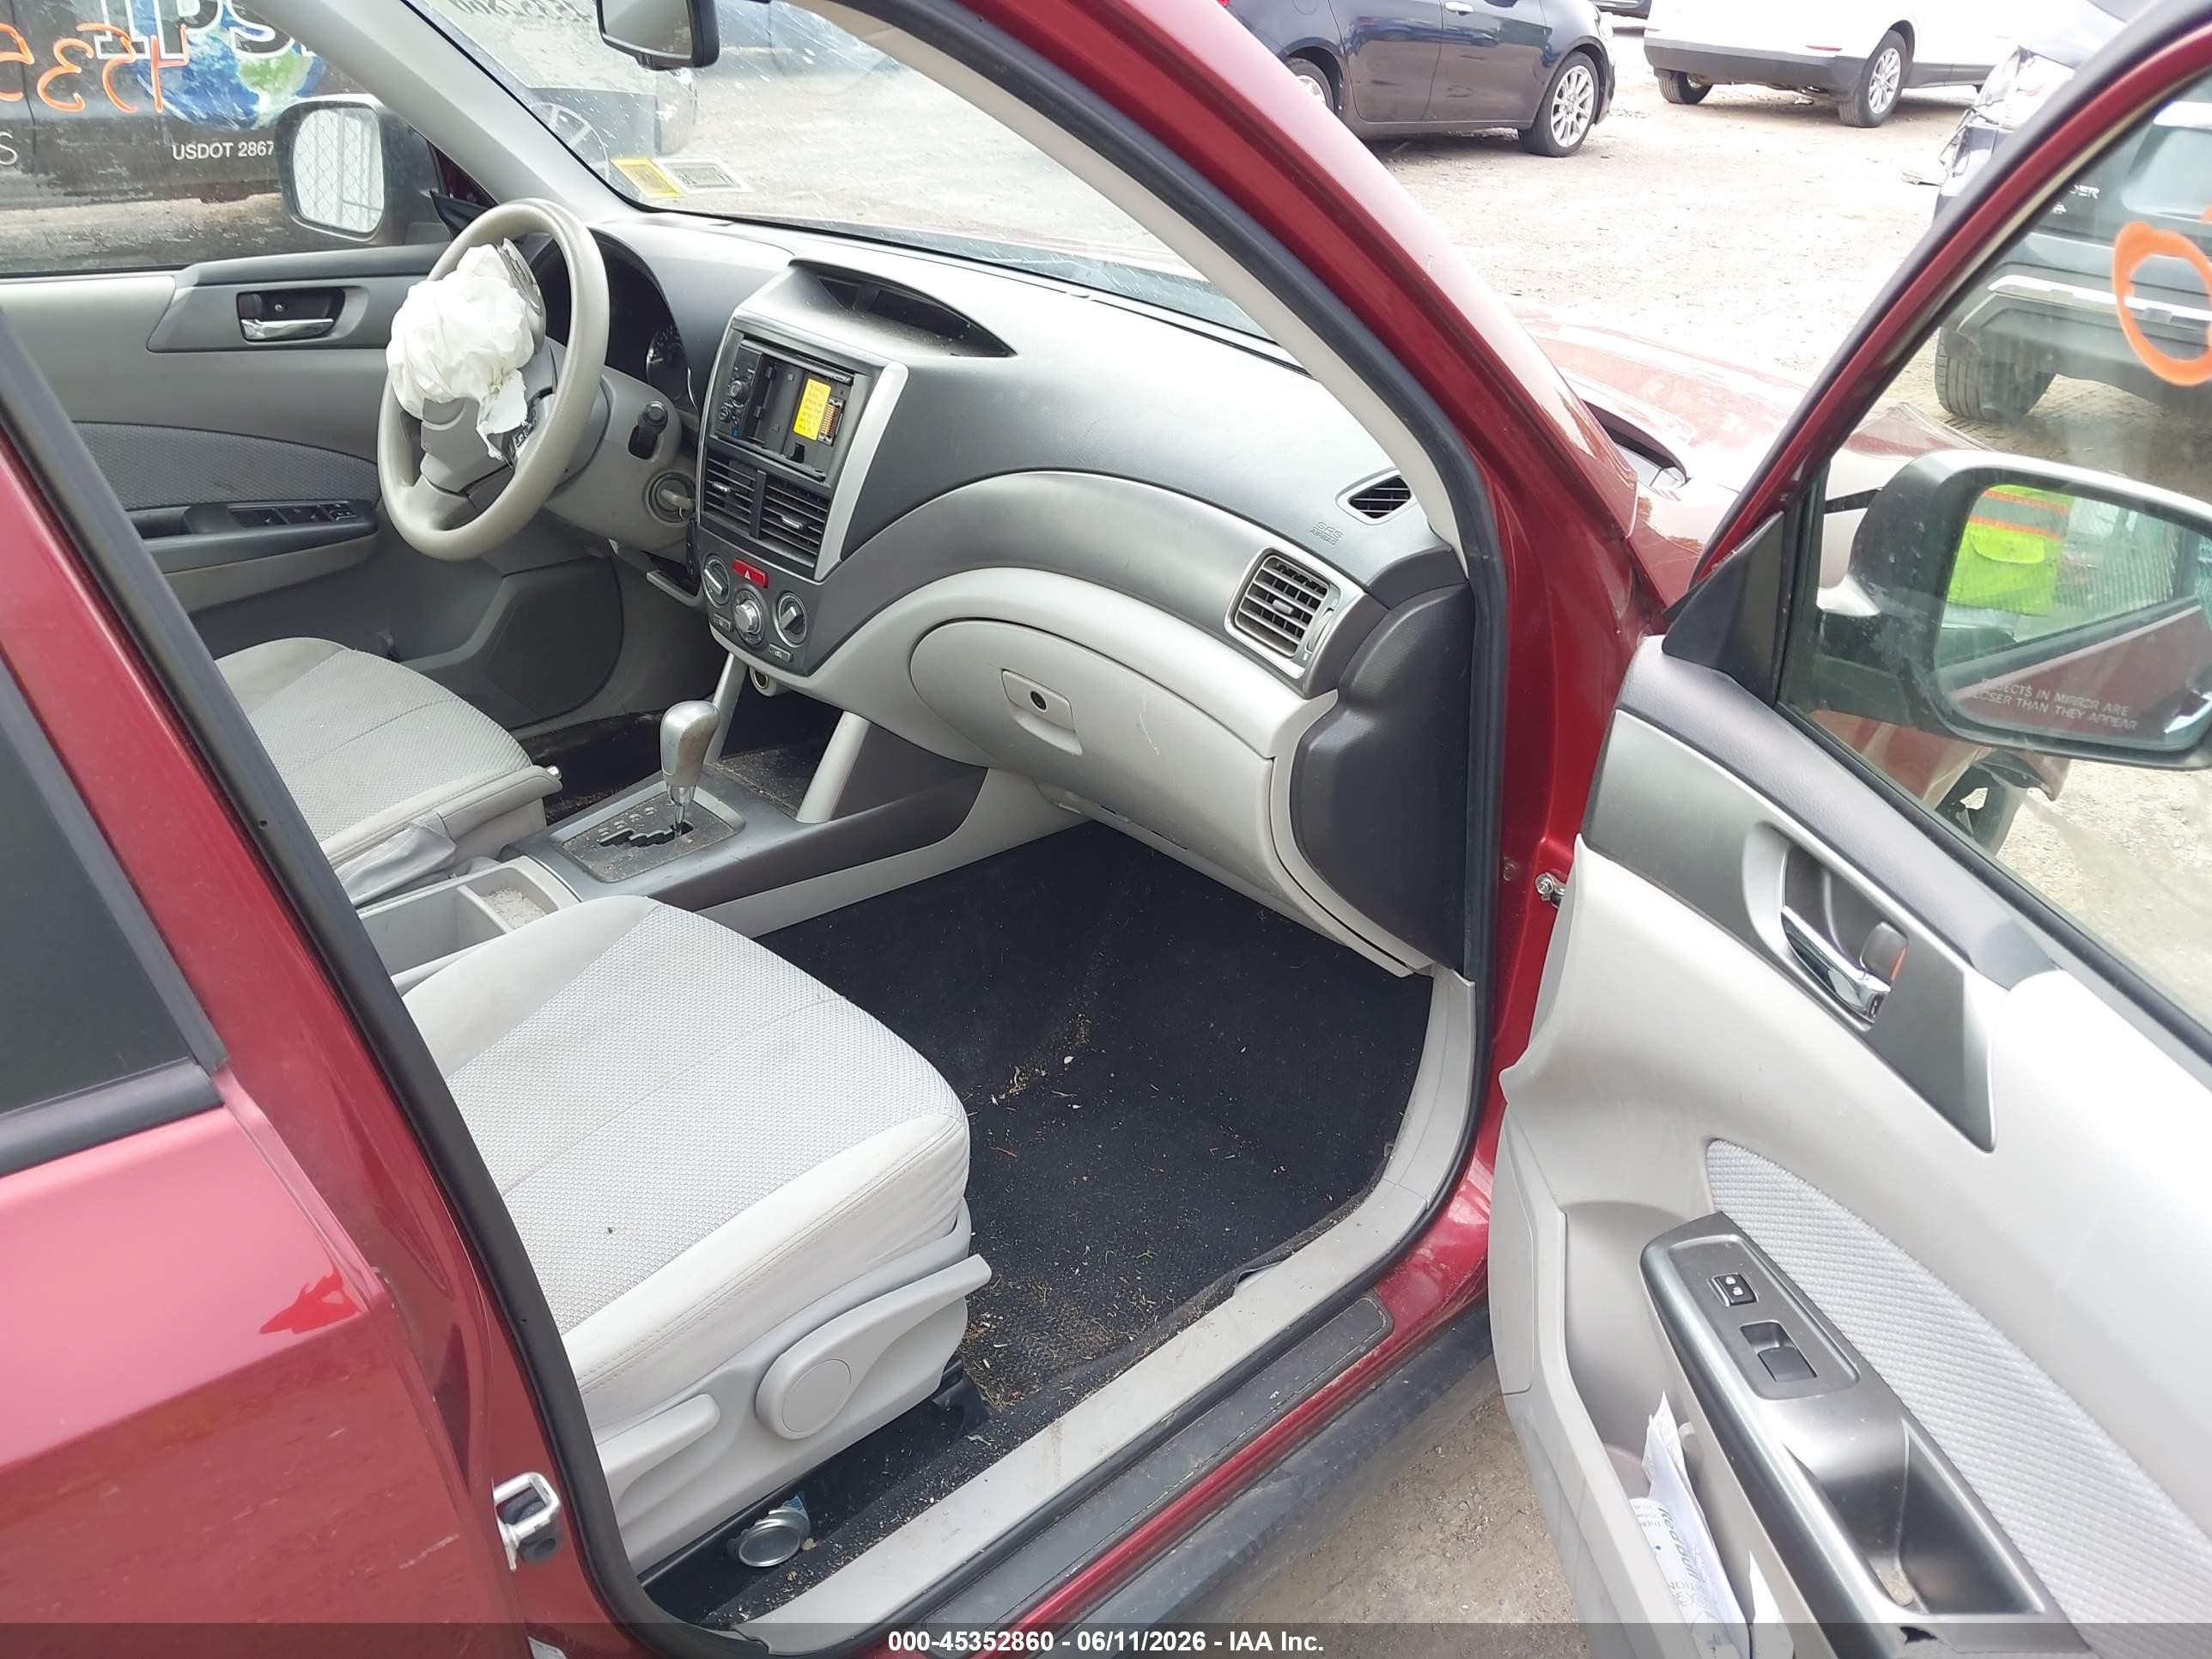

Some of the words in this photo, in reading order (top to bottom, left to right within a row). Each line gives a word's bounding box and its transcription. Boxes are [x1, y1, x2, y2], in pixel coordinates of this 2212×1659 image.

[172, 142, 234, 161] USDOT
[238, 140, 275, 157] 2867
[1310, 529, 1339, 545] AIRBAG
[2016, 697, 2049, 714] THAN
[2055, 705, 2087, 720] THEY
[2087, 712, 2137, 730] APPEAR
[2036, 689, 2051, 701] IN
[2053, 691, 2100, 710] MIRROR
[2102, 702, 2130, 716] ARE
